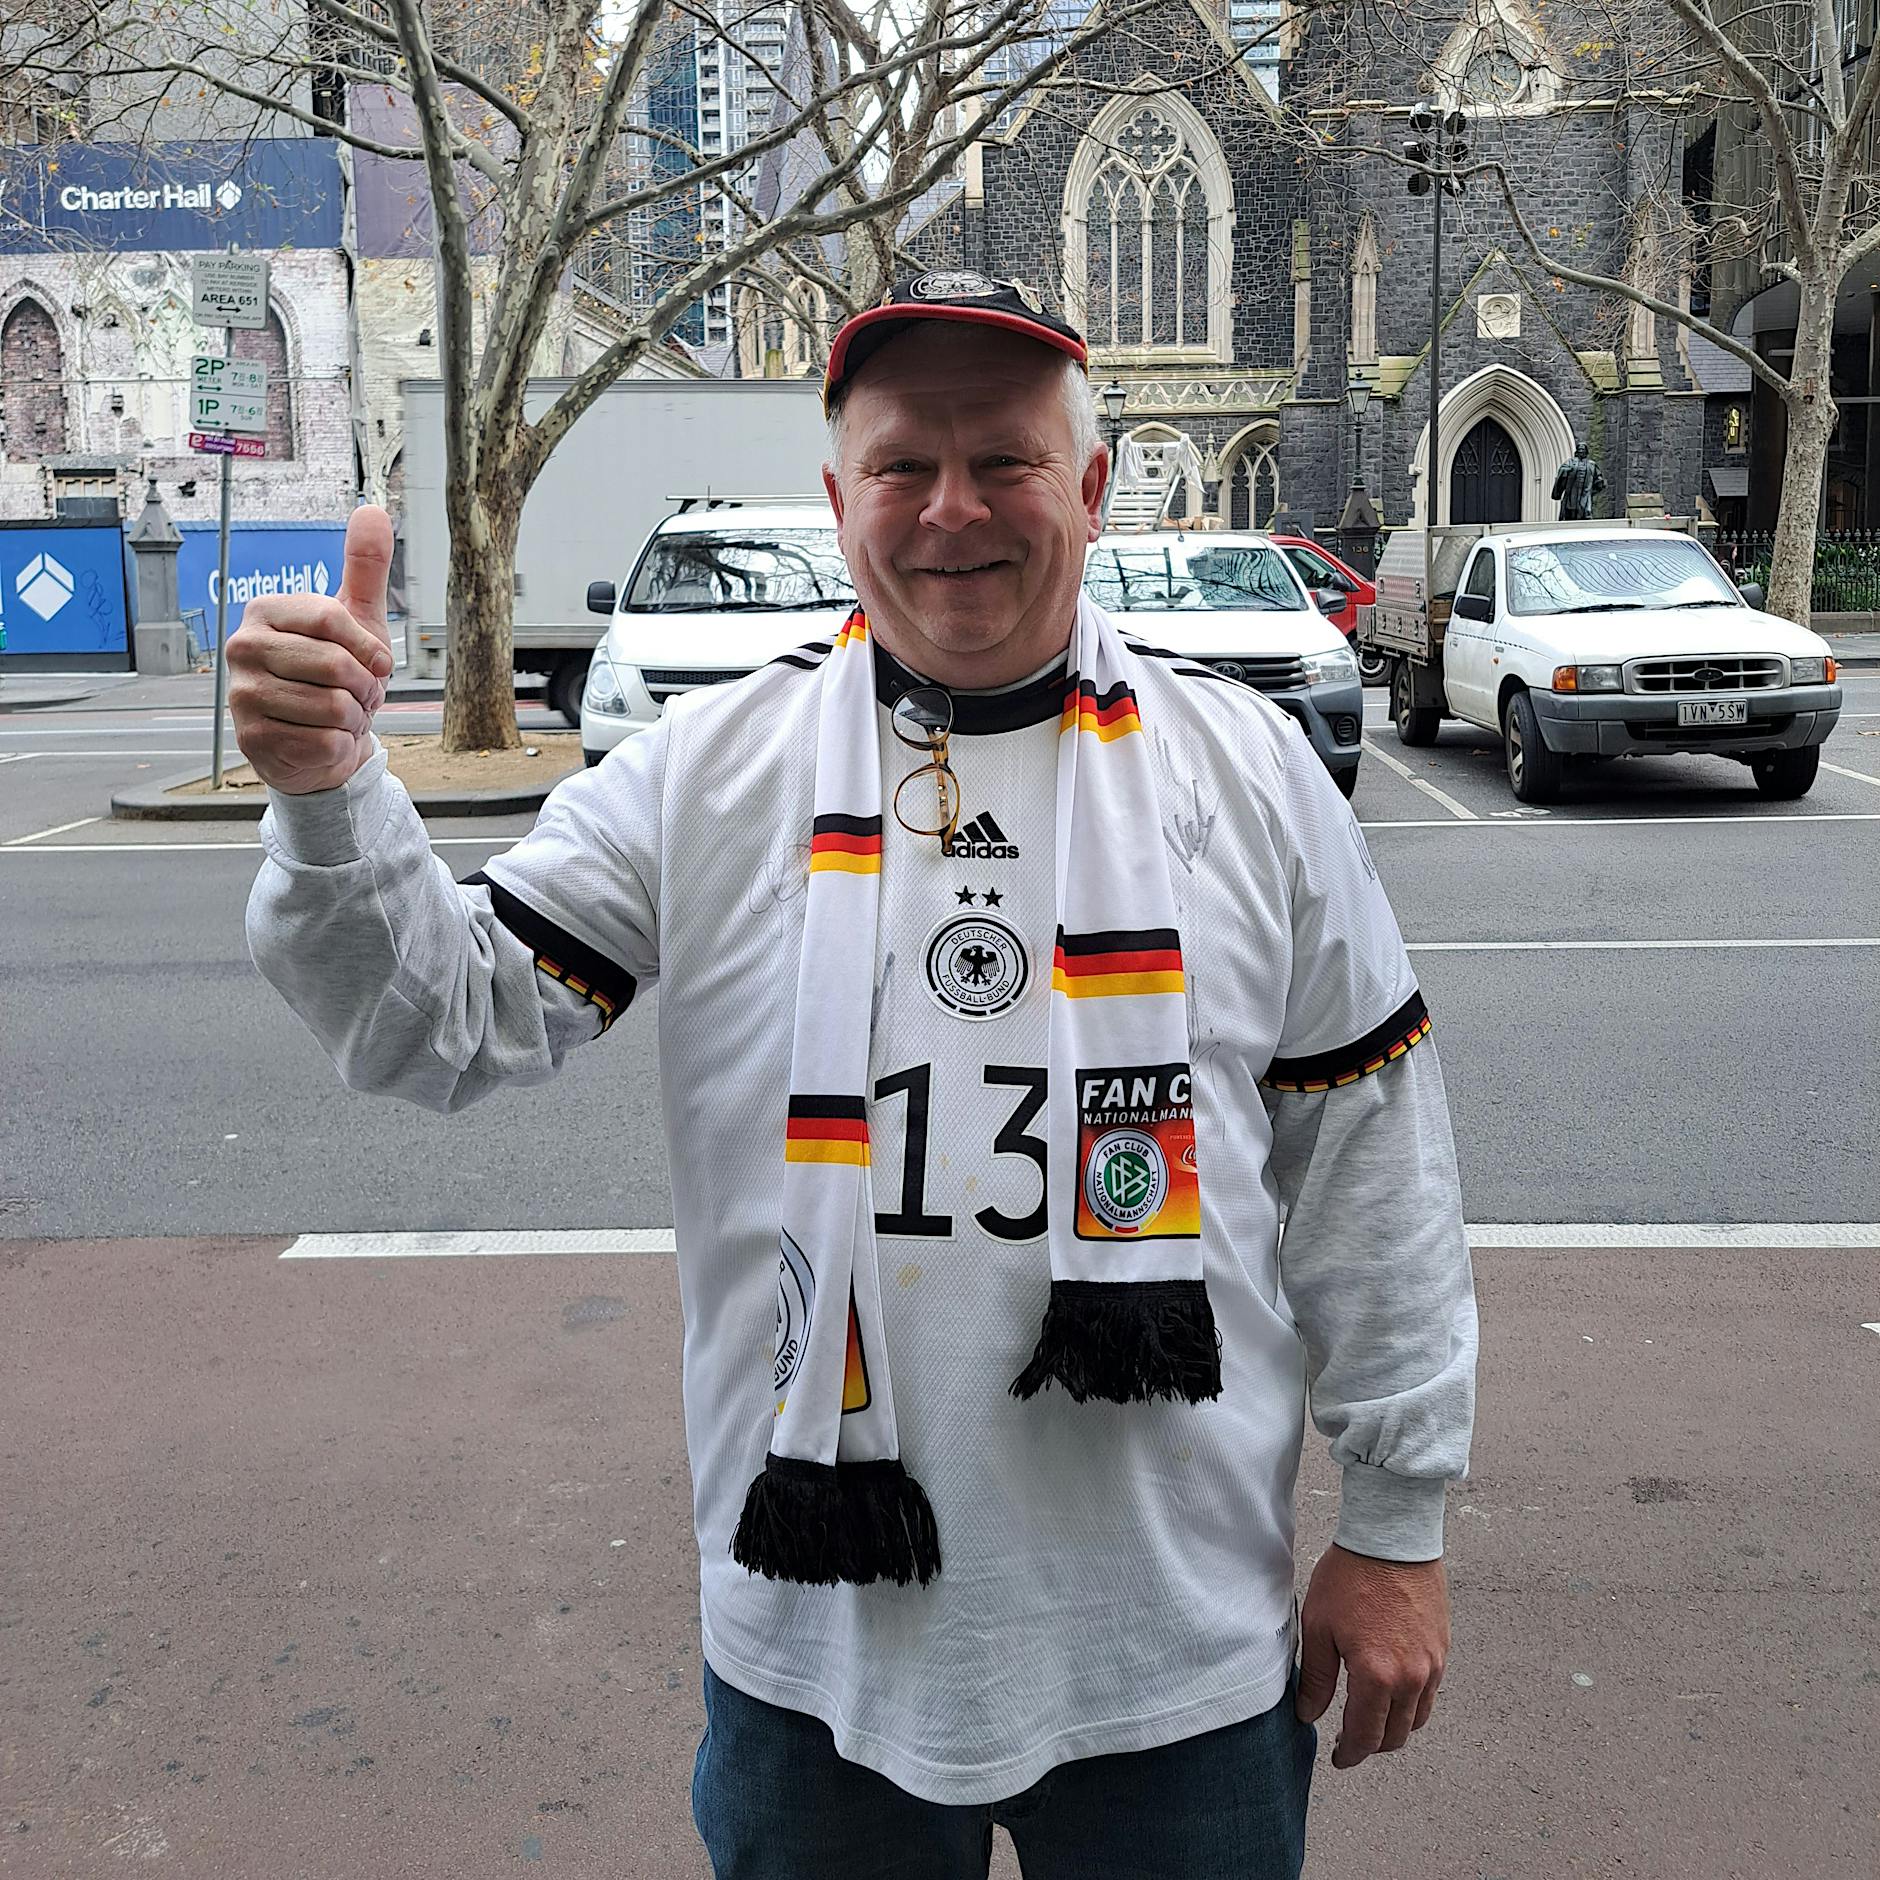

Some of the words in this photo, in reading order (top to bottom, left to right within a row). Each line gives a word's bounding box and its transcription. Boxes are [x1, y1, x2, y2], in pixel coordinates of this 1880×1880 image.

[60, 186, 161, 211] Charter
[163, 183, 212, 208] Hall
[219, 262, 260, 272] PARKING
[201, 293, 236, 304] AREA
[239, 296, 258, 305] 651
[195, 358, 225, 375] 2P
[198, 399, 220, 415] 1P
[208, 568, 281, 605] Charter
[281, 564, 312, 595] Hall
[1683, 705, 1707, 721] 1VN
[1719, 703, 1745, 719] 5SW
[942, 841, 1019, 859] adidas
[951, 929, 1007, 951] DEUTSCHER
[1082, 1076, 1156, 1109] FAN
[873, 1062, 1049, 1243] 13
[1102, 1142, 1121, 1158] FAN
[1124, 1141, 1149, 1158] CLUB
[1096, 1171, 1157, 1219] NATIONALMANNSCHAFT
